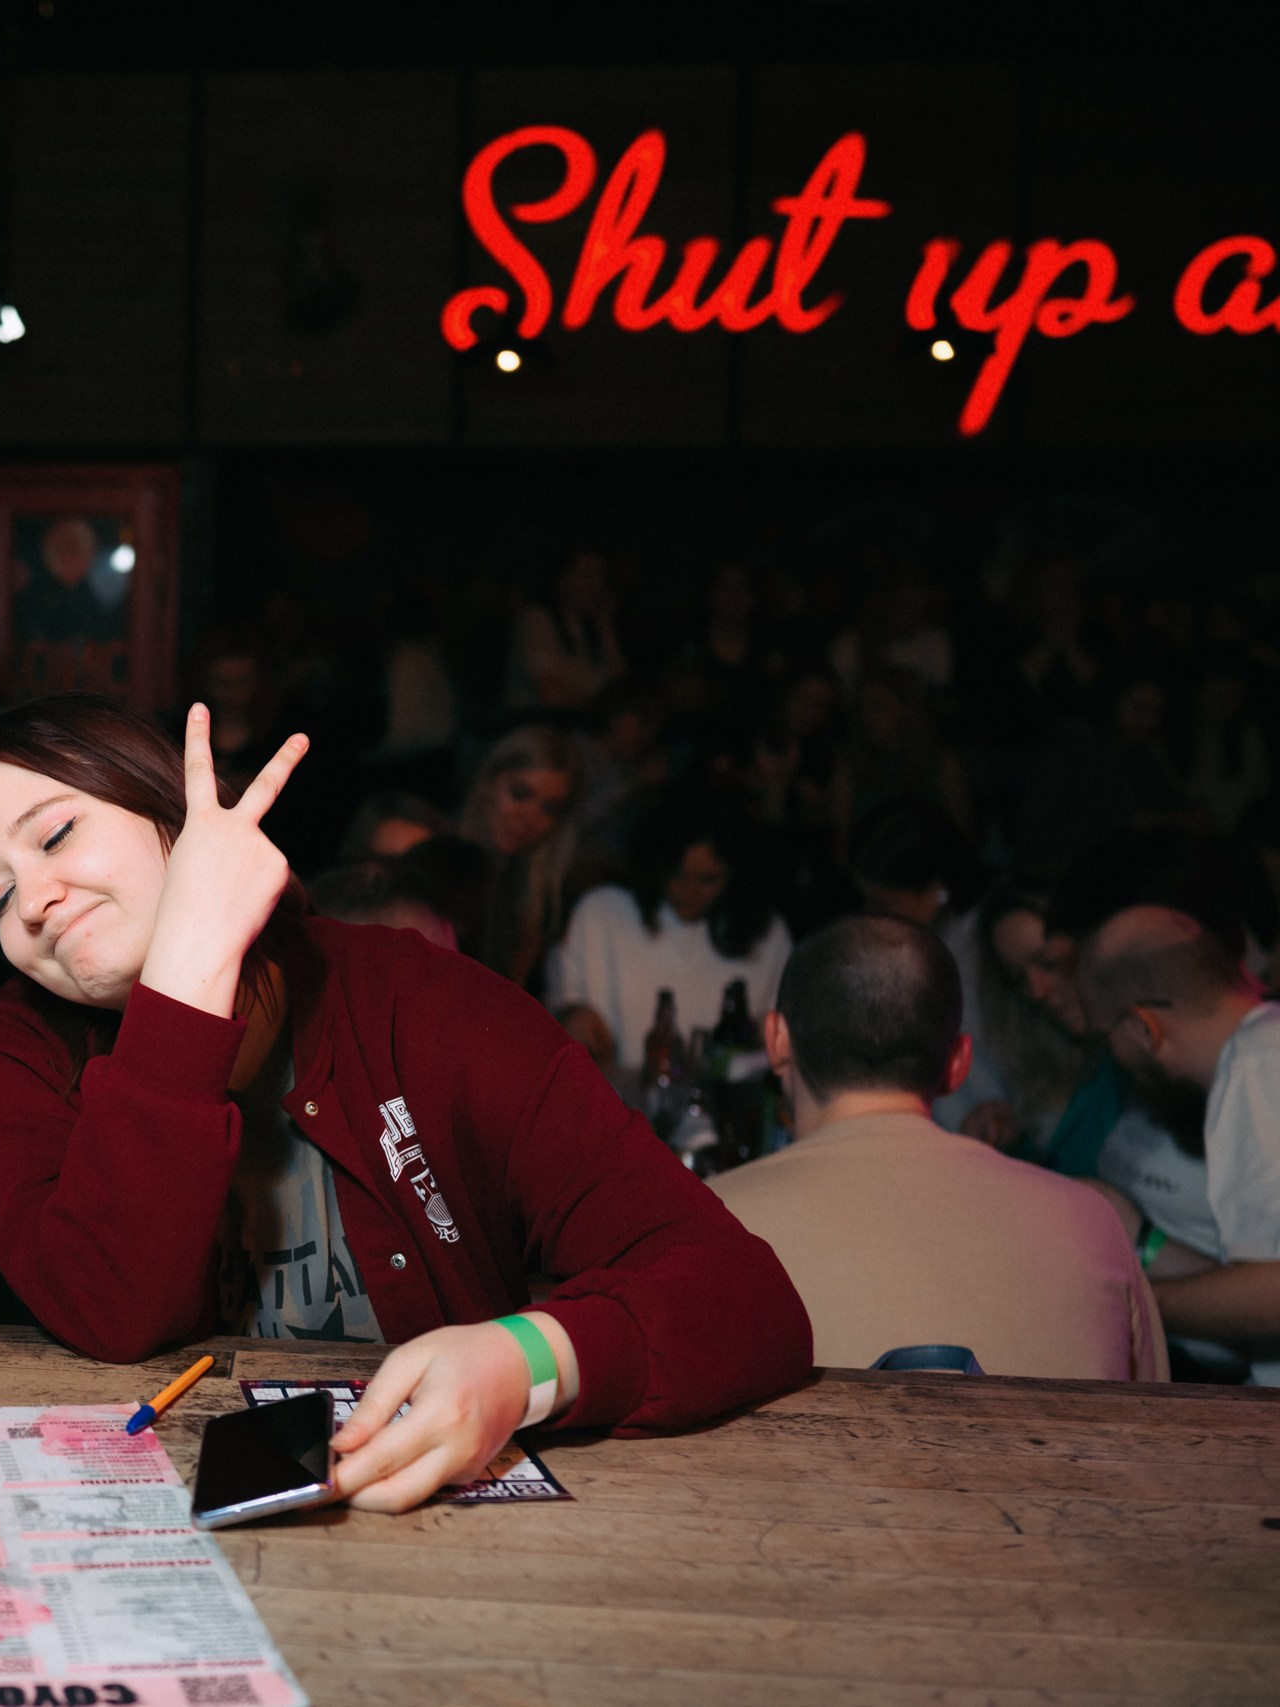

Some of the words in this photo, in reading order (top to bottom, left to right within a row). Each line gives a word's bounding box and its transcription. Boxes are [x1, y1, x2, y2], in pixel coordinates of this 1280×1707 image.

[442, 125, 890, 352] Shut
[904, 238, 1137, 437] up
[1172, 234, 1280, 336] a
